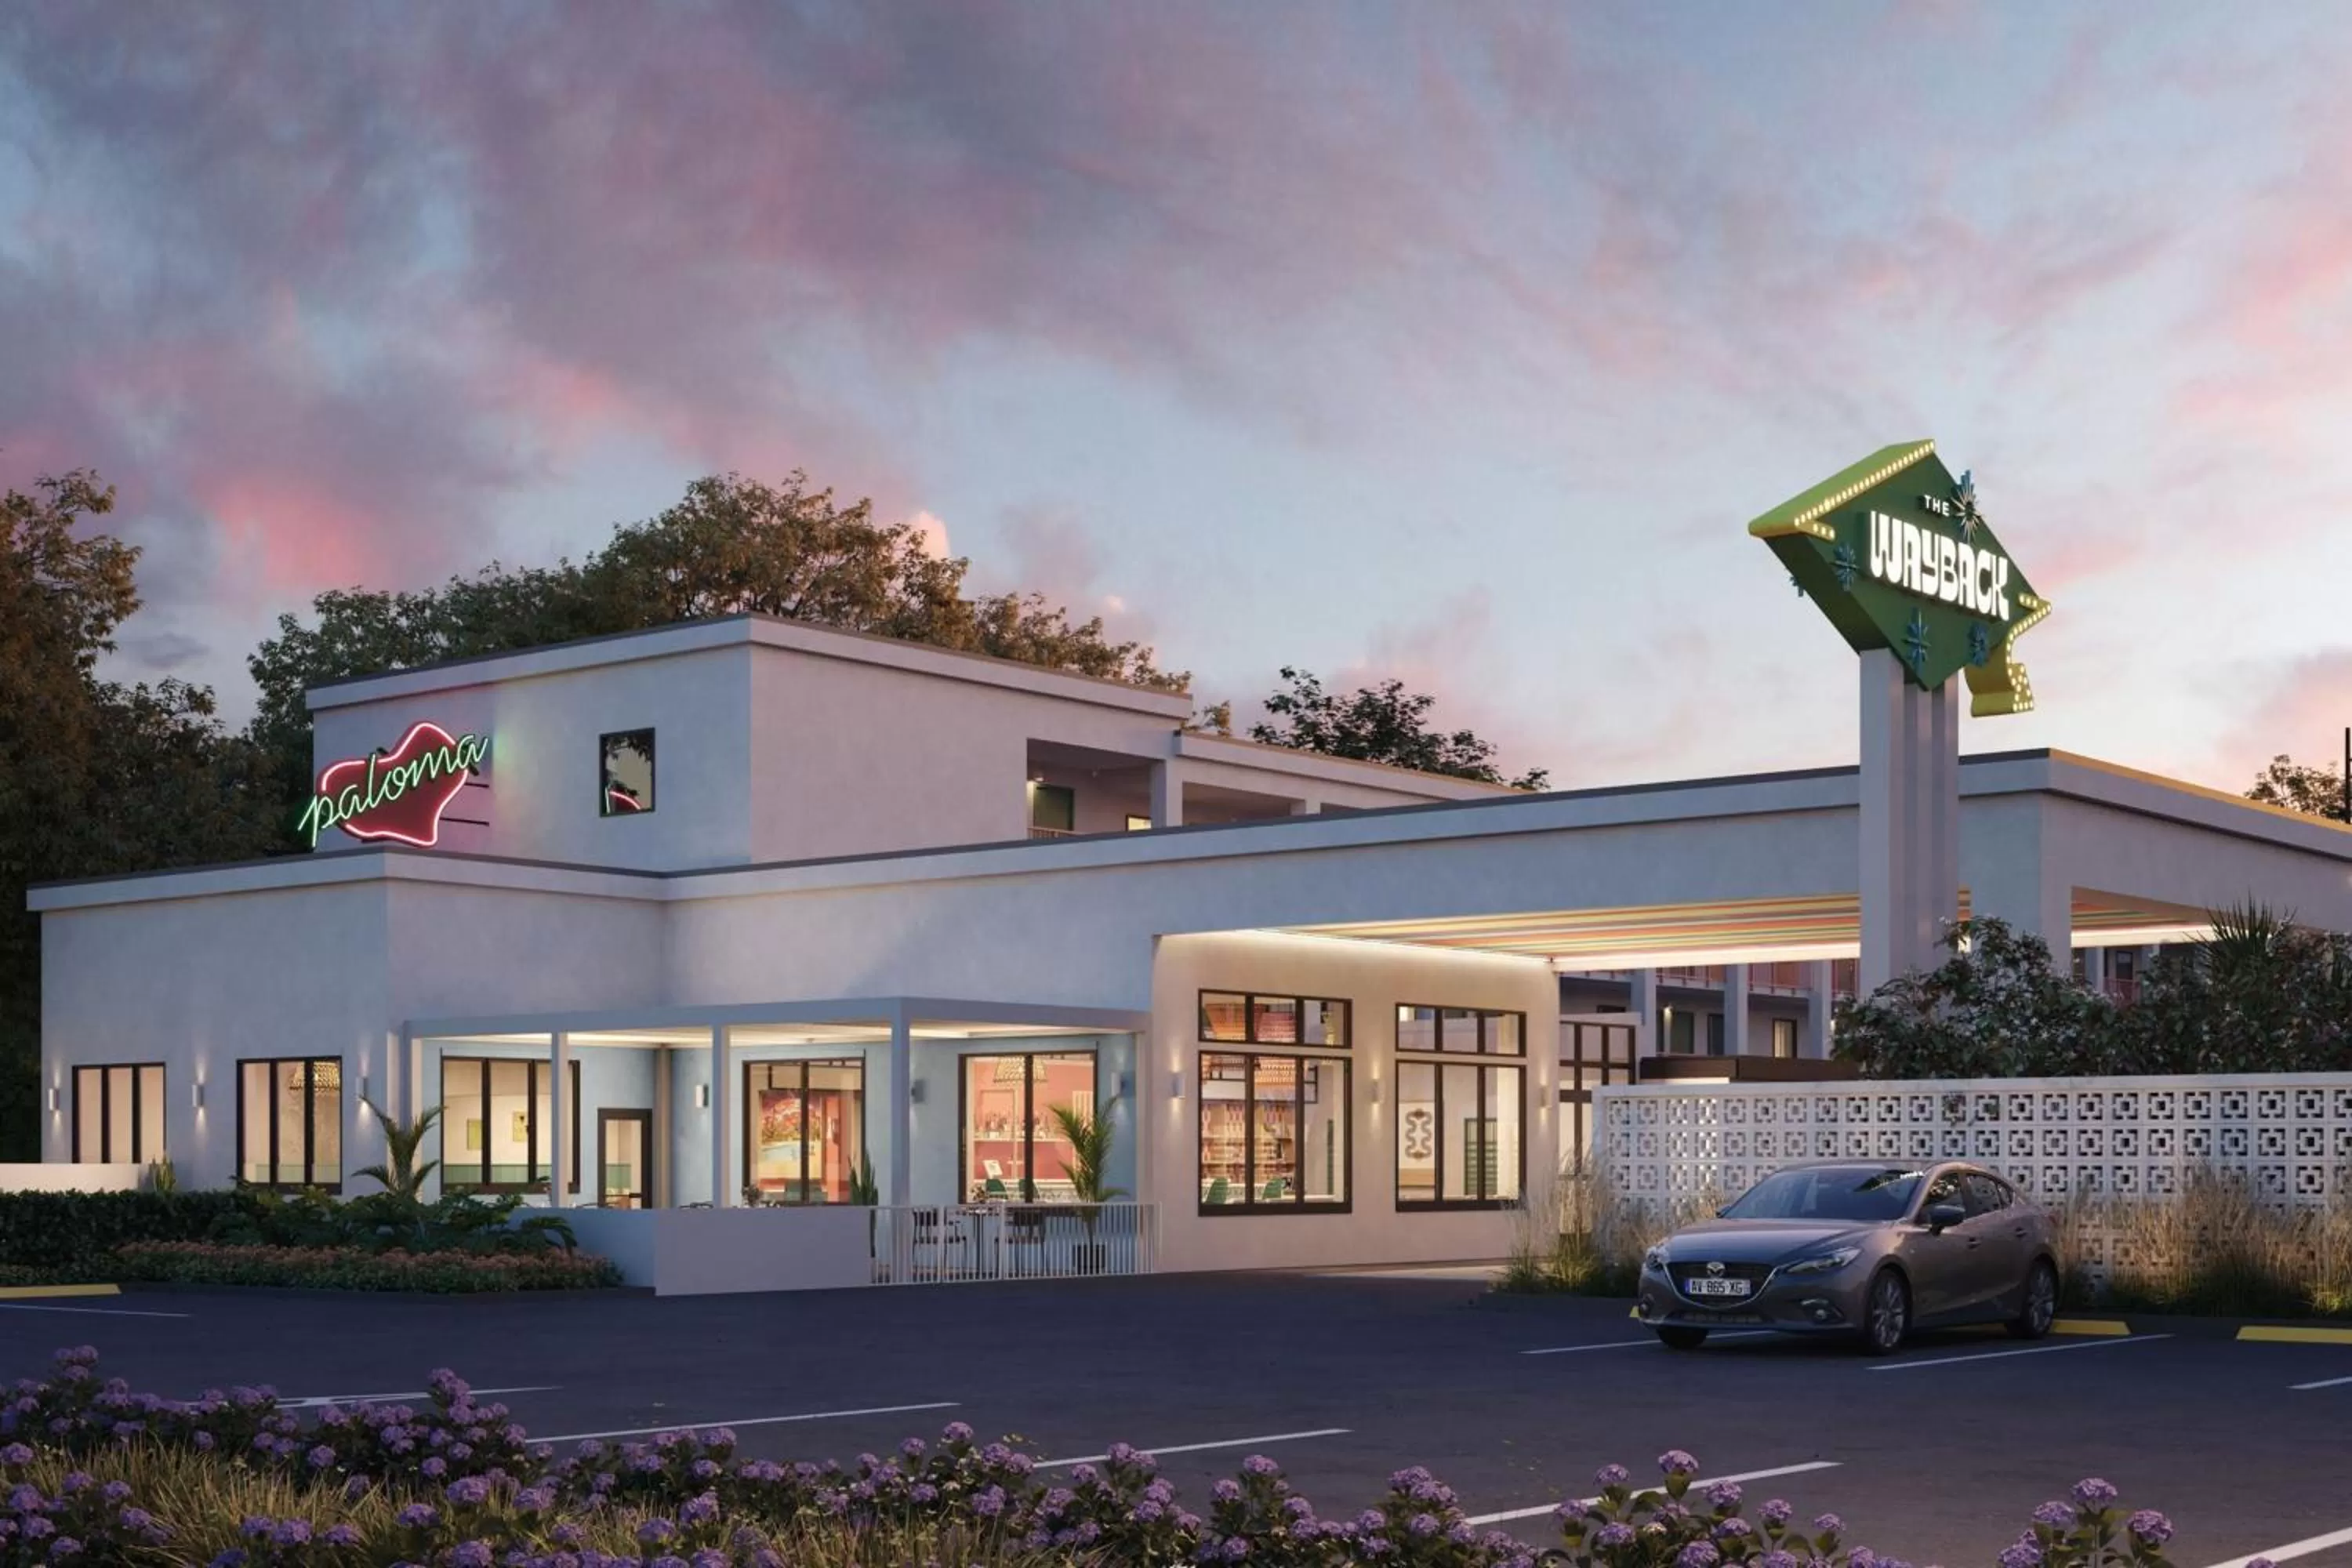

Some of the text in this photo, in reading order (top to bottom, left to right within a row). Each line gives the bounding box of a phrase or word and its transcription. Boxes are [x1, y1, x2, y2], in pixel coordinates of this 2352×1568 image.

[1925, 495, 1950, 516] THE
[1870, 510, 2009, 621] WAYBACK
[298, 735, 488, 848] paloma
